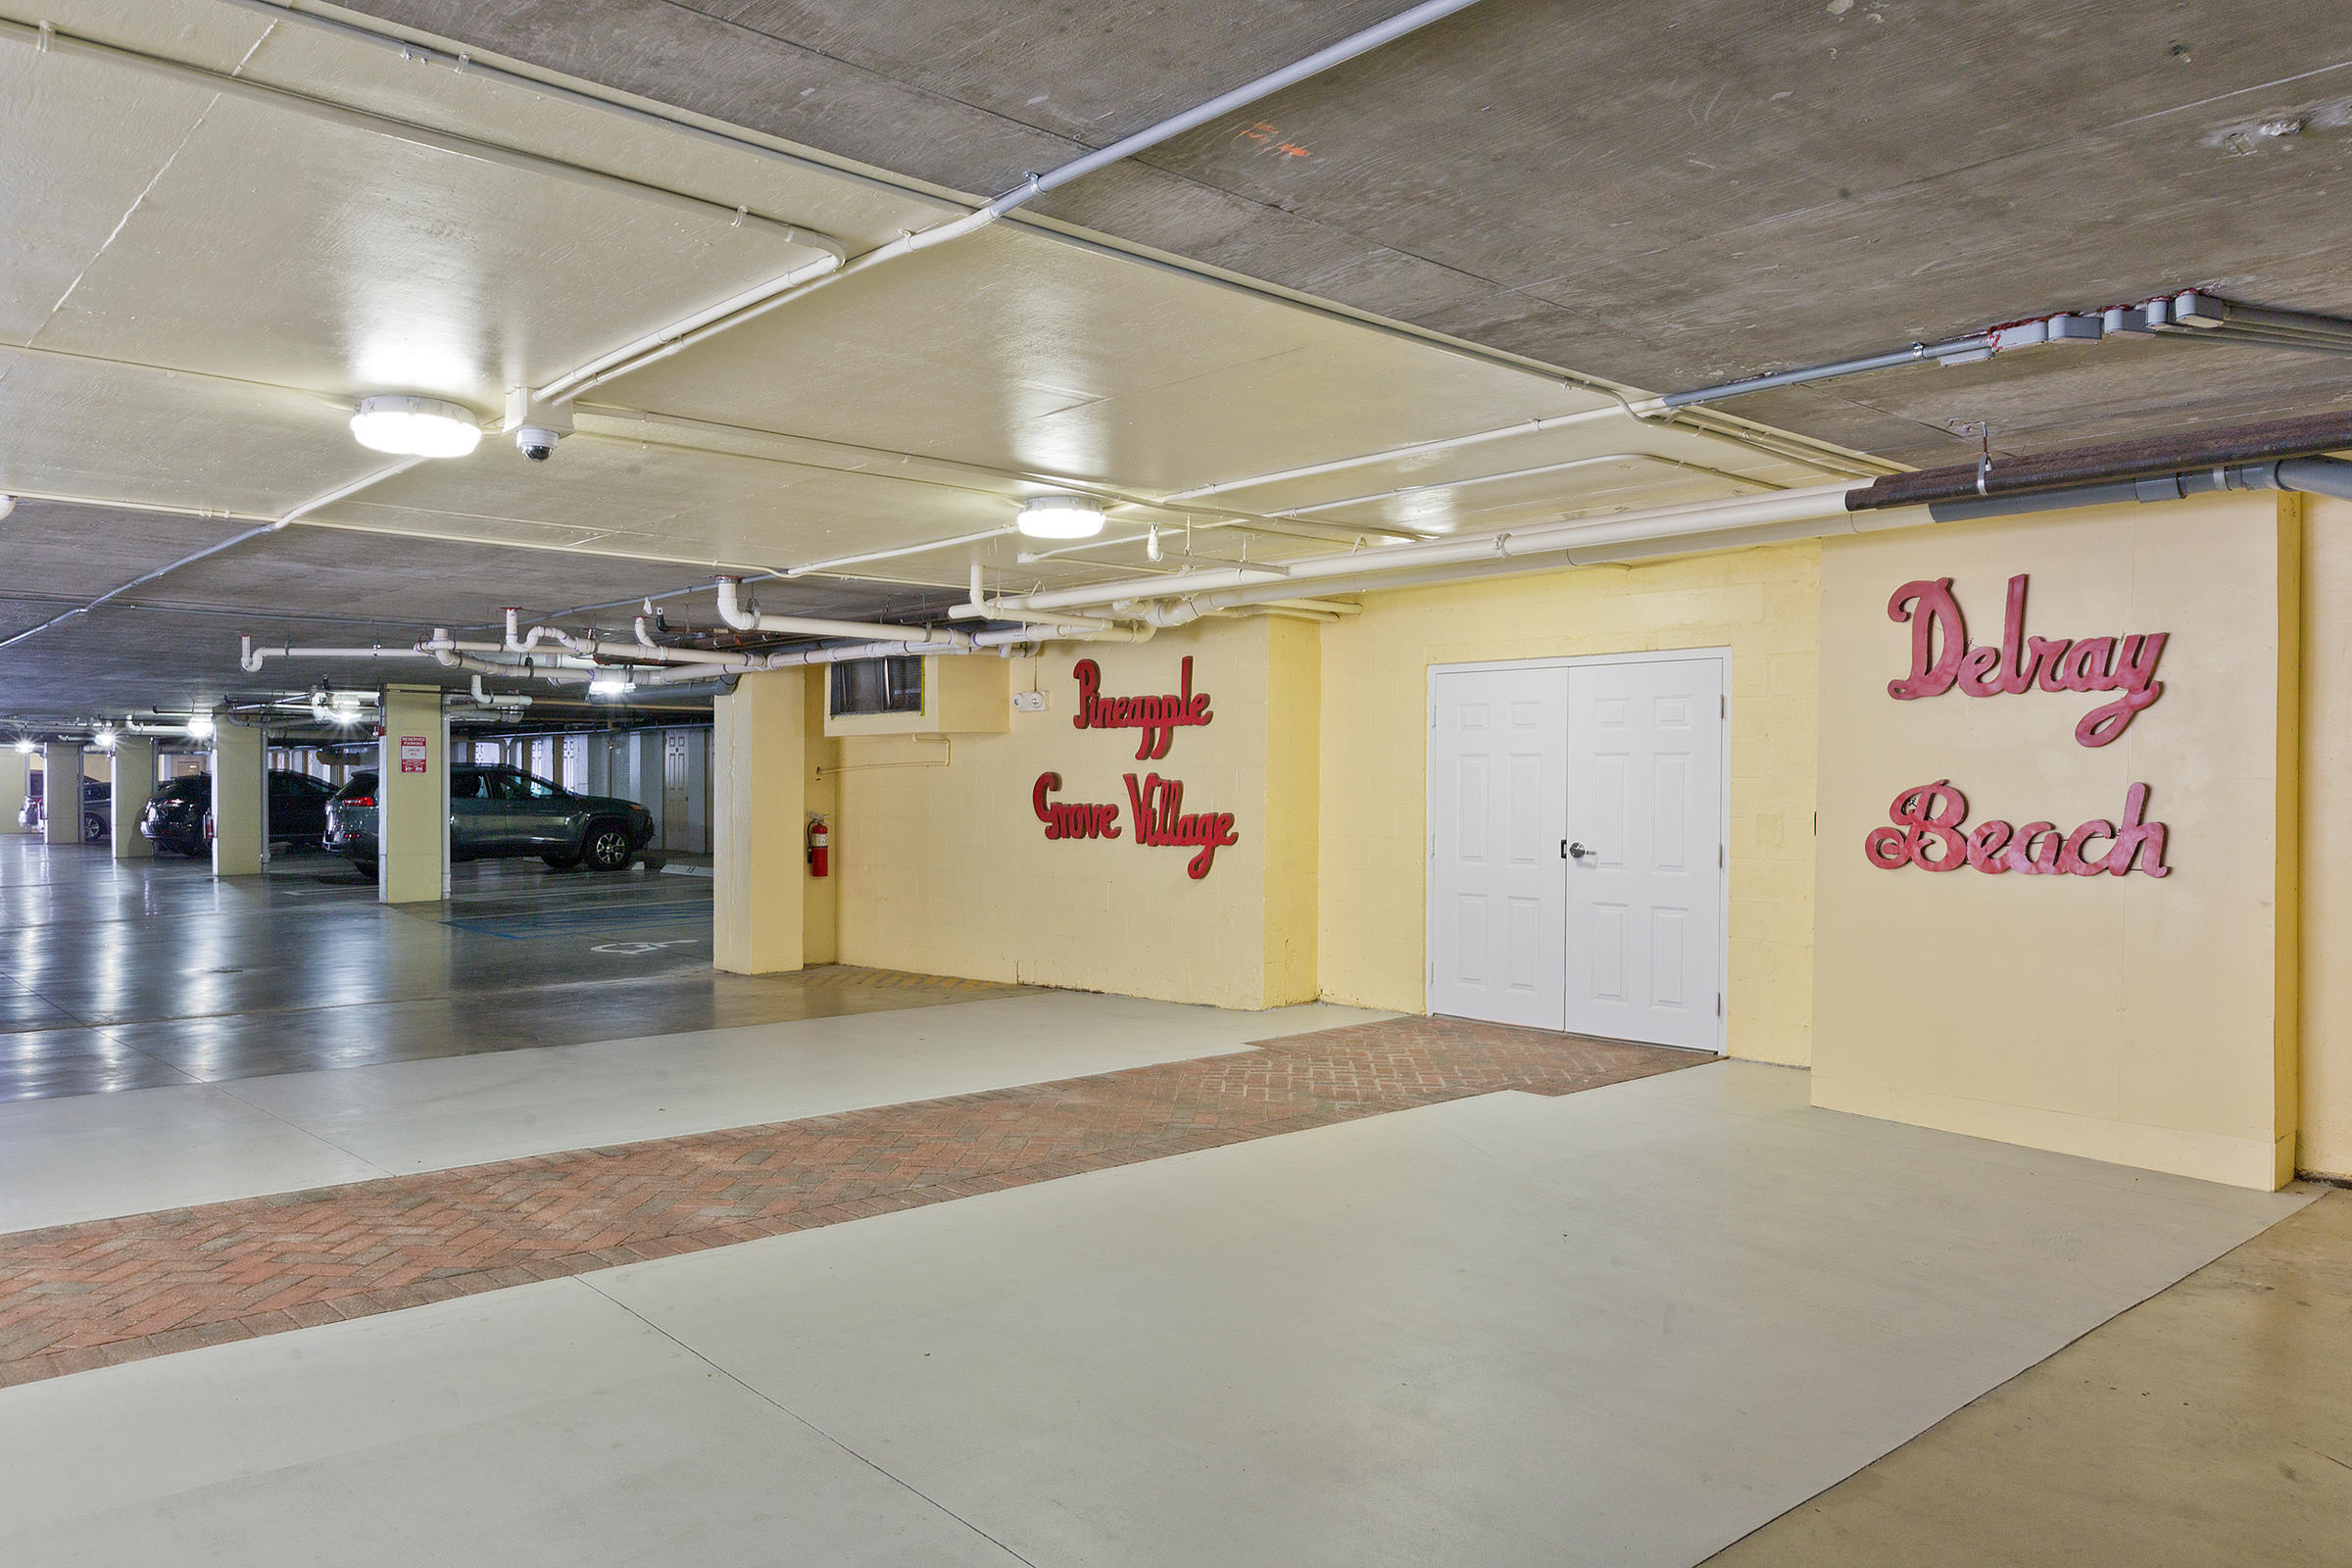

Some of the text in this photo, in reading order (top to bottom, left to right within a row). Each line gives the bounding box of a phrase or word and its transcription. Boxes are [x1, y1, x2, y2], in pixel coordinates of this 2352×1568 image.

[1073, 656, 1213, 760] Pineapple
[1887, 573, 2170, 748] Delray
[1033, 772, 1239, 879] Grove Village
[1865, 779, 2172, 878] Beach
